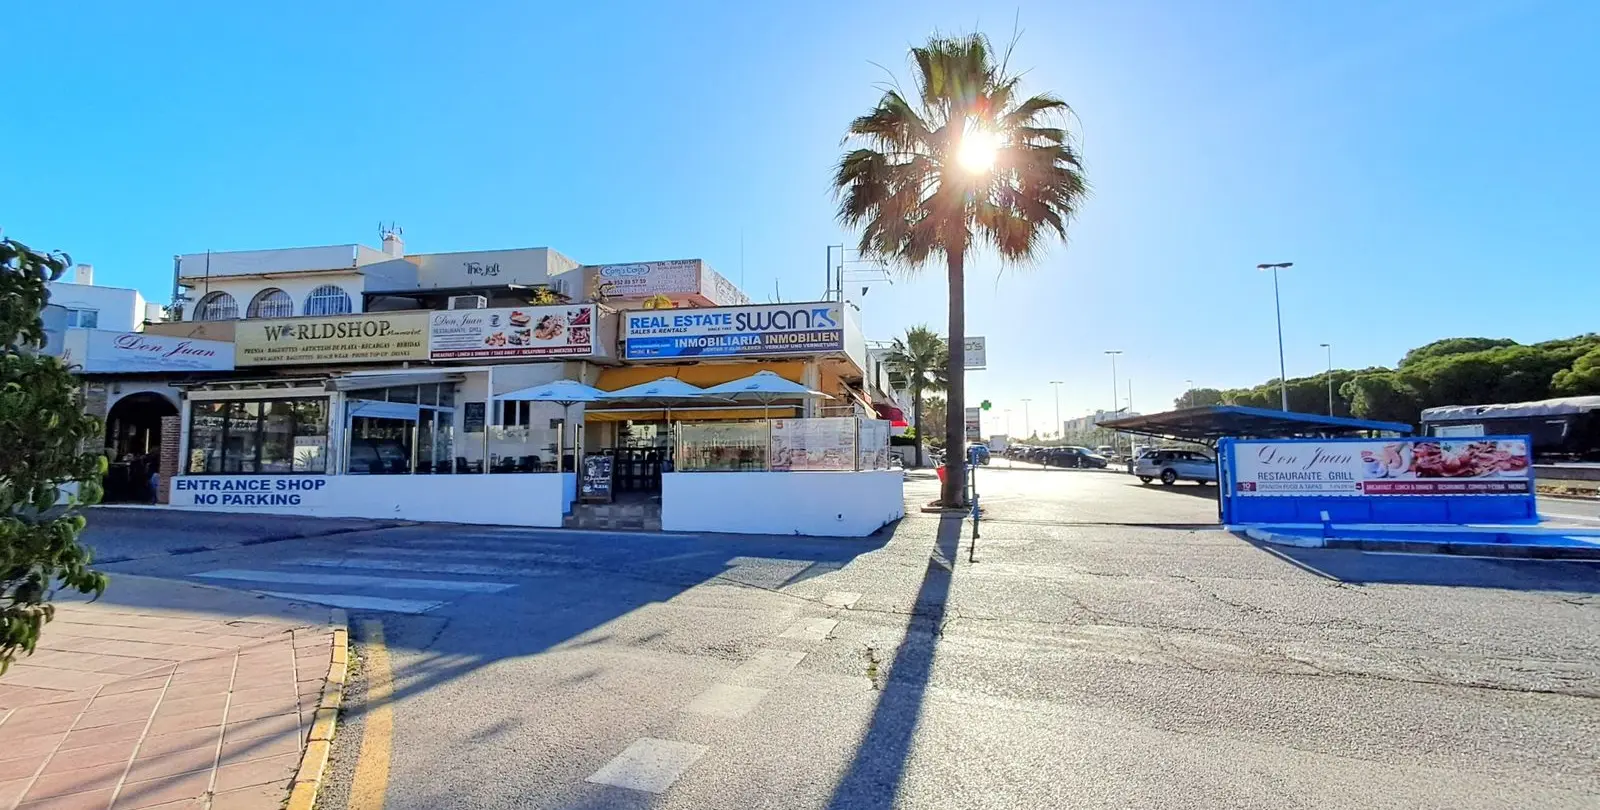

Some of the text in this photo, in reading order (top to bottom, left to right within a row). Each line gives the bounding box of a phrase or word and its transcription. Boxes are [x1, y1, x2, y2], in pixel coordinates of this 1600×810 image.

[431, 312, 483, 327] Don Juan
[630, 313, 732, 329] REAL ESTATE
[113, 333, 216, 358] Don Juan
[674, 335, 762, 348] INMOBILIARIA
[765, 332, 840, 345] INMOBILIEN
[803, 341, 839, 349] VERMIETUNG
[1258, 445, 1352, 470] Don Juan
[1257, 471, 1355, 481] RESTAURANTE GRILL
[176, 479, 326, 491] ENTRANCE SHOP
[194, 494, 301, 505] NO PARKING
